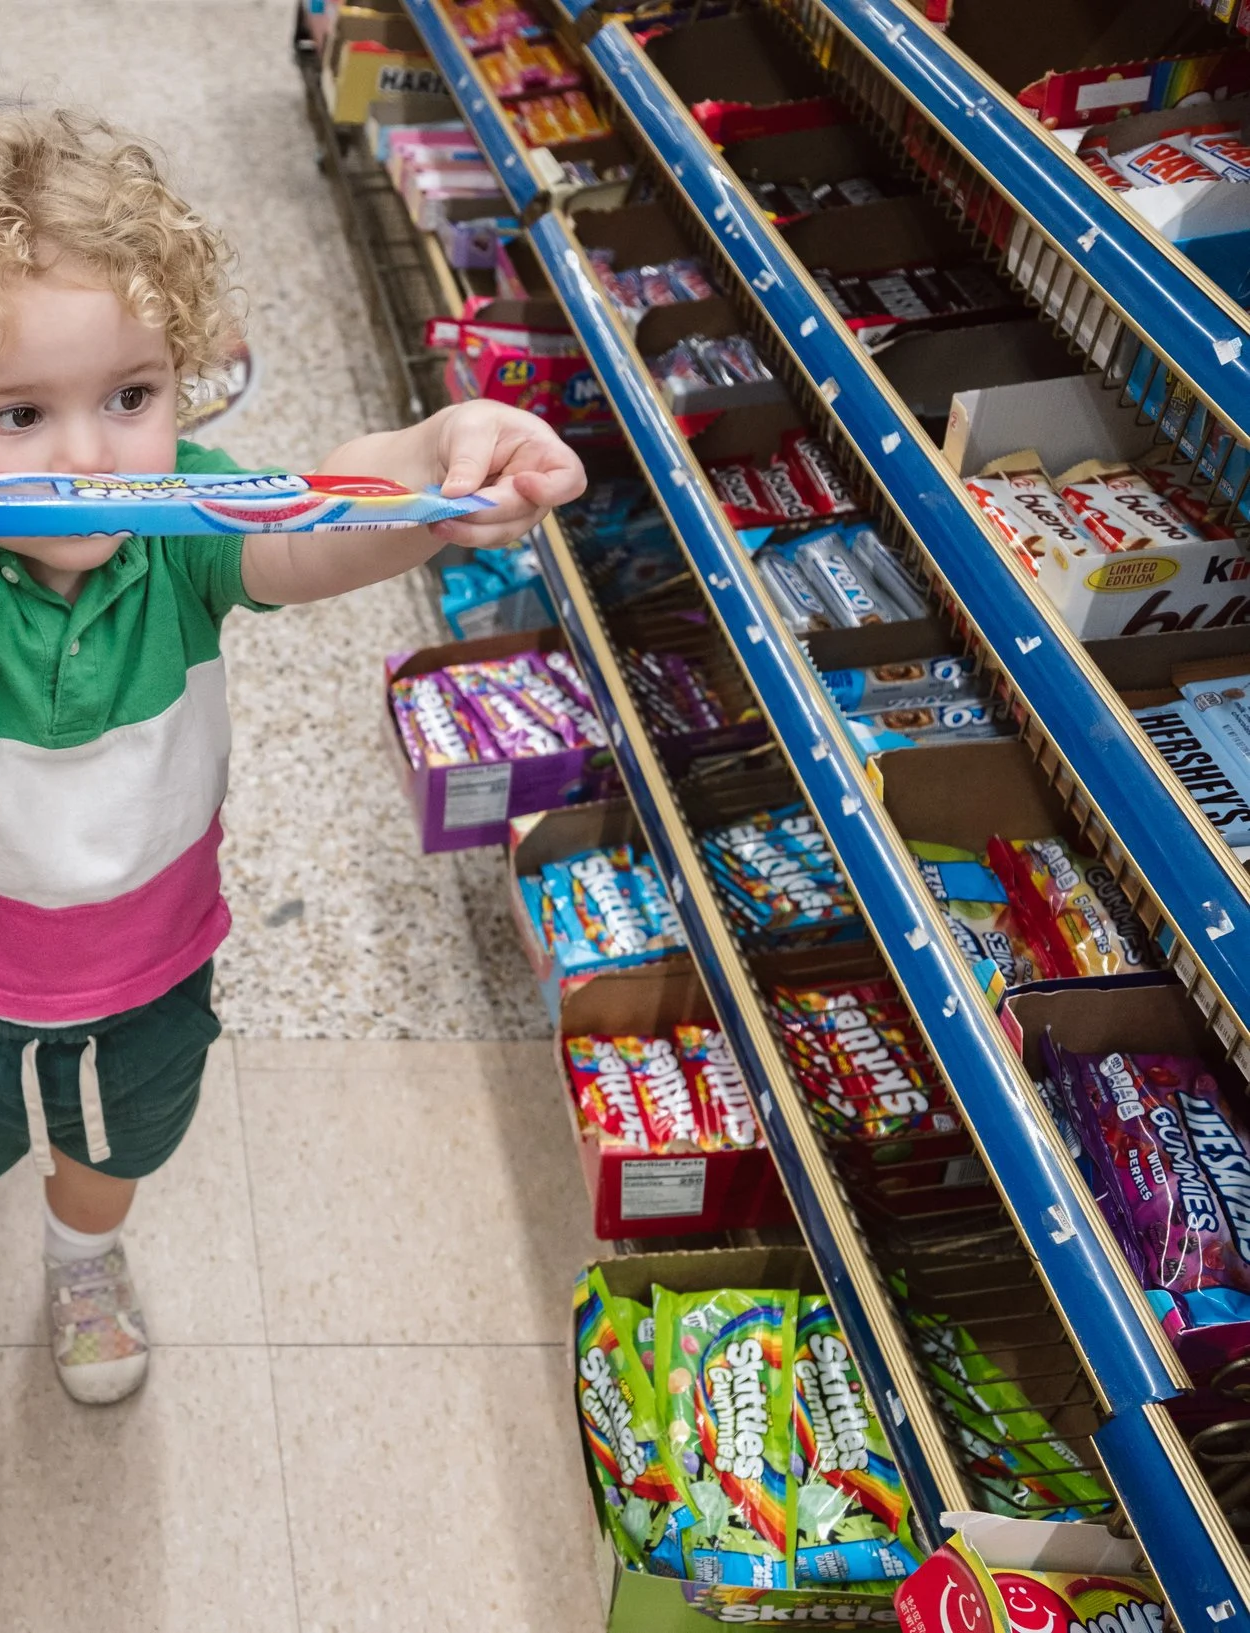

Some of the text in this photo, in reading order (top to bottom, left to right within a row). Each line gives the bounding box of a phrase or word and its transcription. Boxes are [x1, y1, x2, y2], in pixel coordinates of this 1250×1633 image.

[1014, 494, 1078, 541] bueno
[1115, 493, 1188, 541] bueno
[1106, 573, 1155, 587] EDITION
[1109, 561, 1158, 576] LIMITED
[1127, 1149, 1153, 1201] BERRIES
[1147, 1150, 1166, 1185] WILD
[1149, 1106, 1218, 1233] GUMMIES
[580, 1346, 647, 1477] Skittles
[708, 1366, 734, 1473] Gummies
[726, 1338, 769, 1480] Skittles
[795, 1359, 839, 1474] Gummies
[809, 1333, 870, 1472] Skittles
[717, 1603, 899, 1624] Skittle
